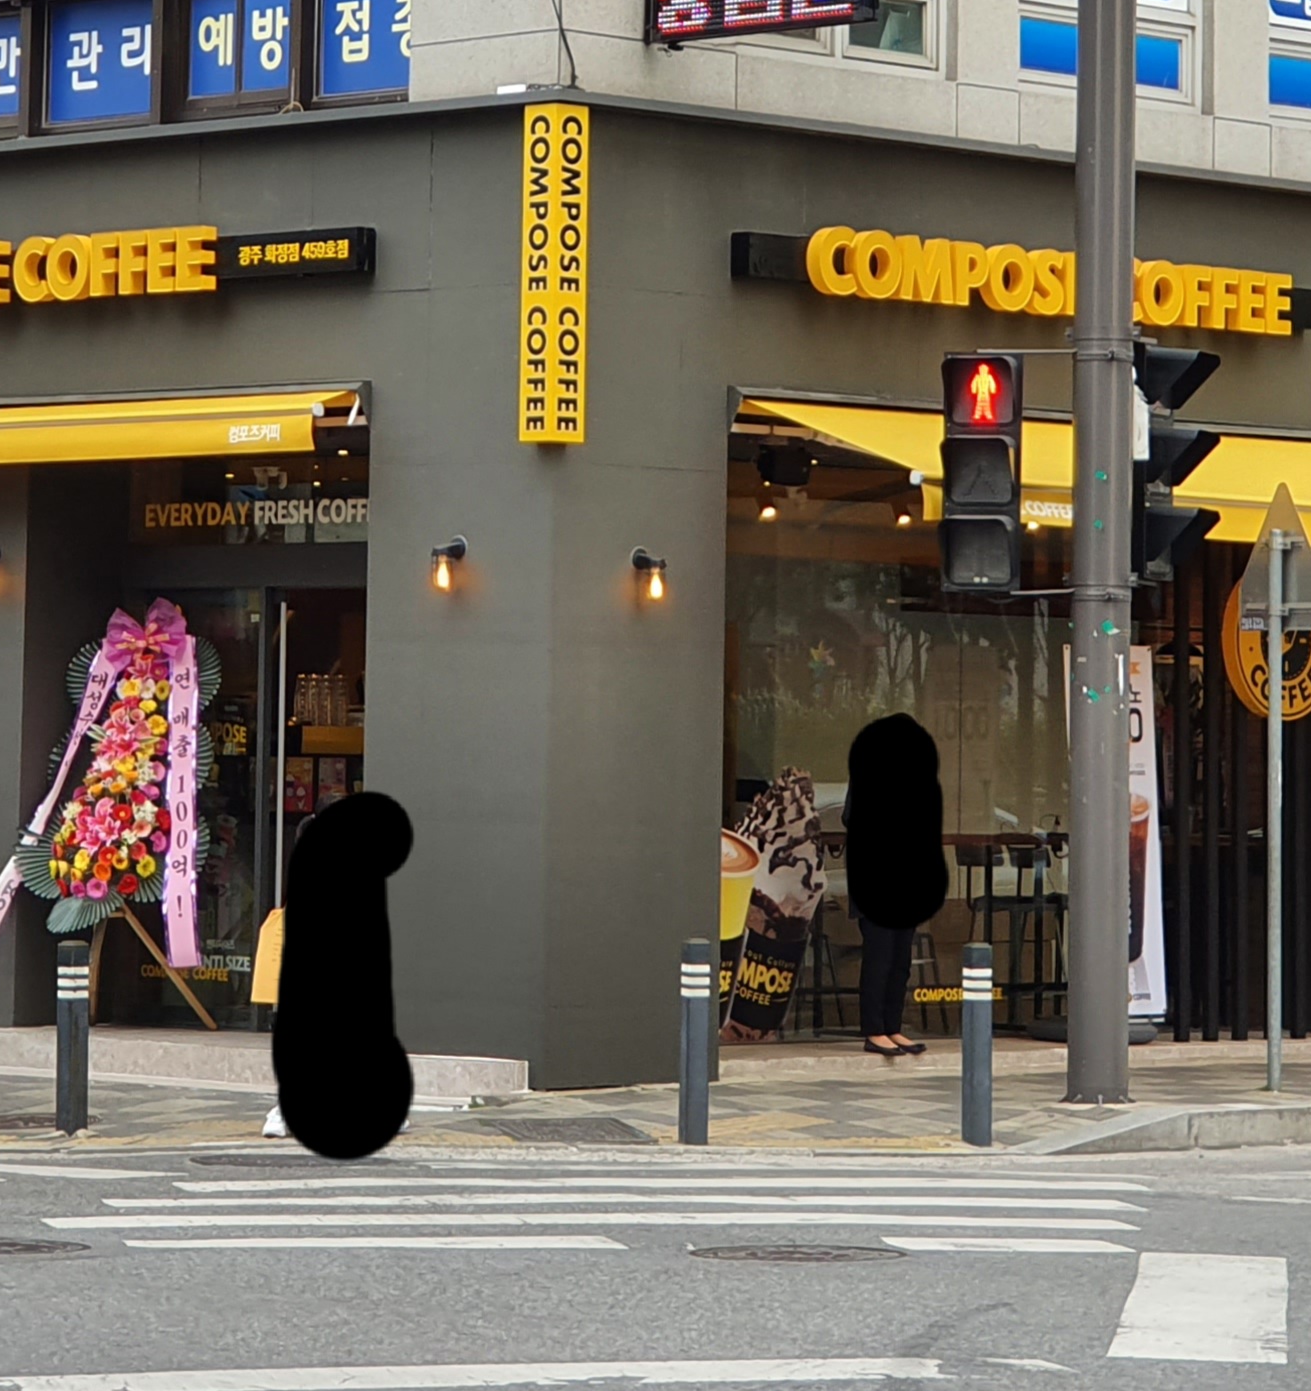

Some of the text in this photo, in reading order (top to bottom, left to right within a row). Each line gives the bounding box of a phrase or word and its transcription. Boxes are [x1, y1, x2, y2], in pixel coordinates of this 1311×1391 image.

[14, 224, 218, 304] COFFEE
[525, 115, 551, 432] COMPOSE COFFEE
[556, 115, 583, 433] COMPOSE COFFEE
[1132, 257, 1293, 336] OFFEE
[145, 497, 369, 528] EVERYDAY FRESH COFF
[226, 955, 251, 971] SIZE
